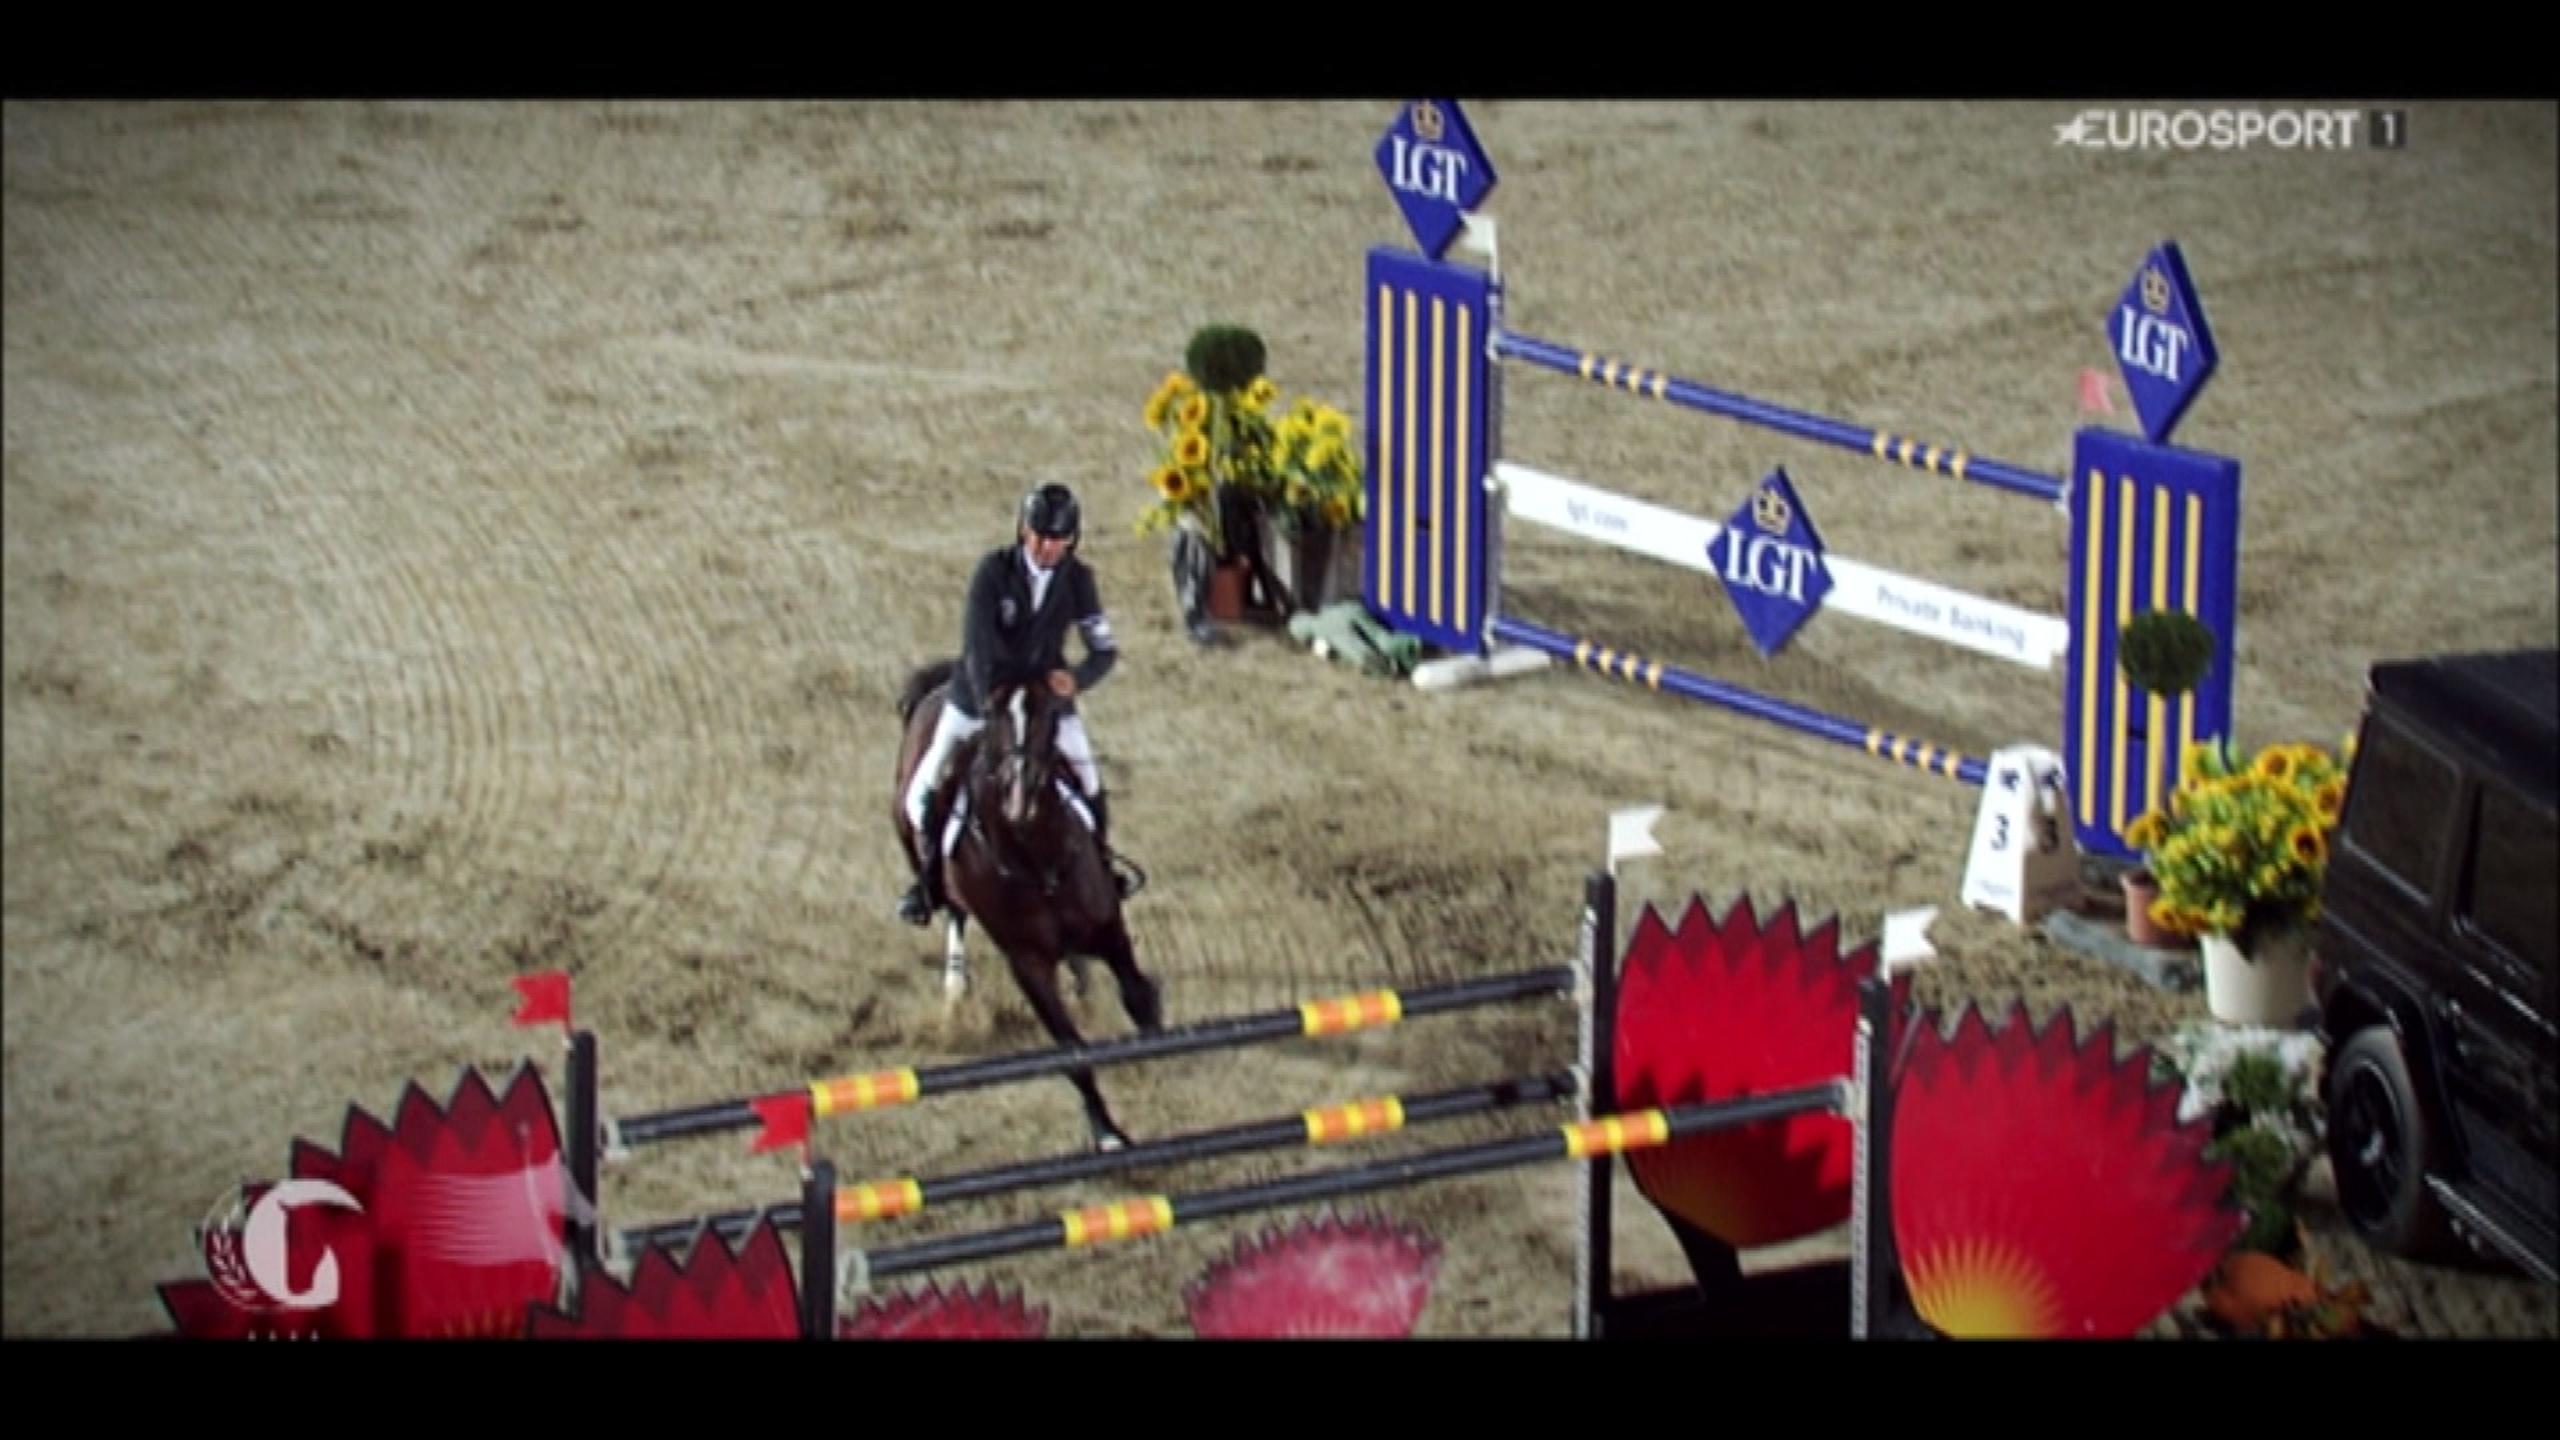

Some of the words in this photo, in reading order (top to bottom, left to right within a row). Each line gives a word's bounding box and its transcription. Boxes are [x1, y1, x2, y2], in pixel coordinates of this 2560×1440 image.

[1392, 134, 1468, 205] LGT
[2120, 303, 2188, 384] LGT
[1725, 526, 1817, 604] LGT
[1990, 813, 2010, 850] 3
